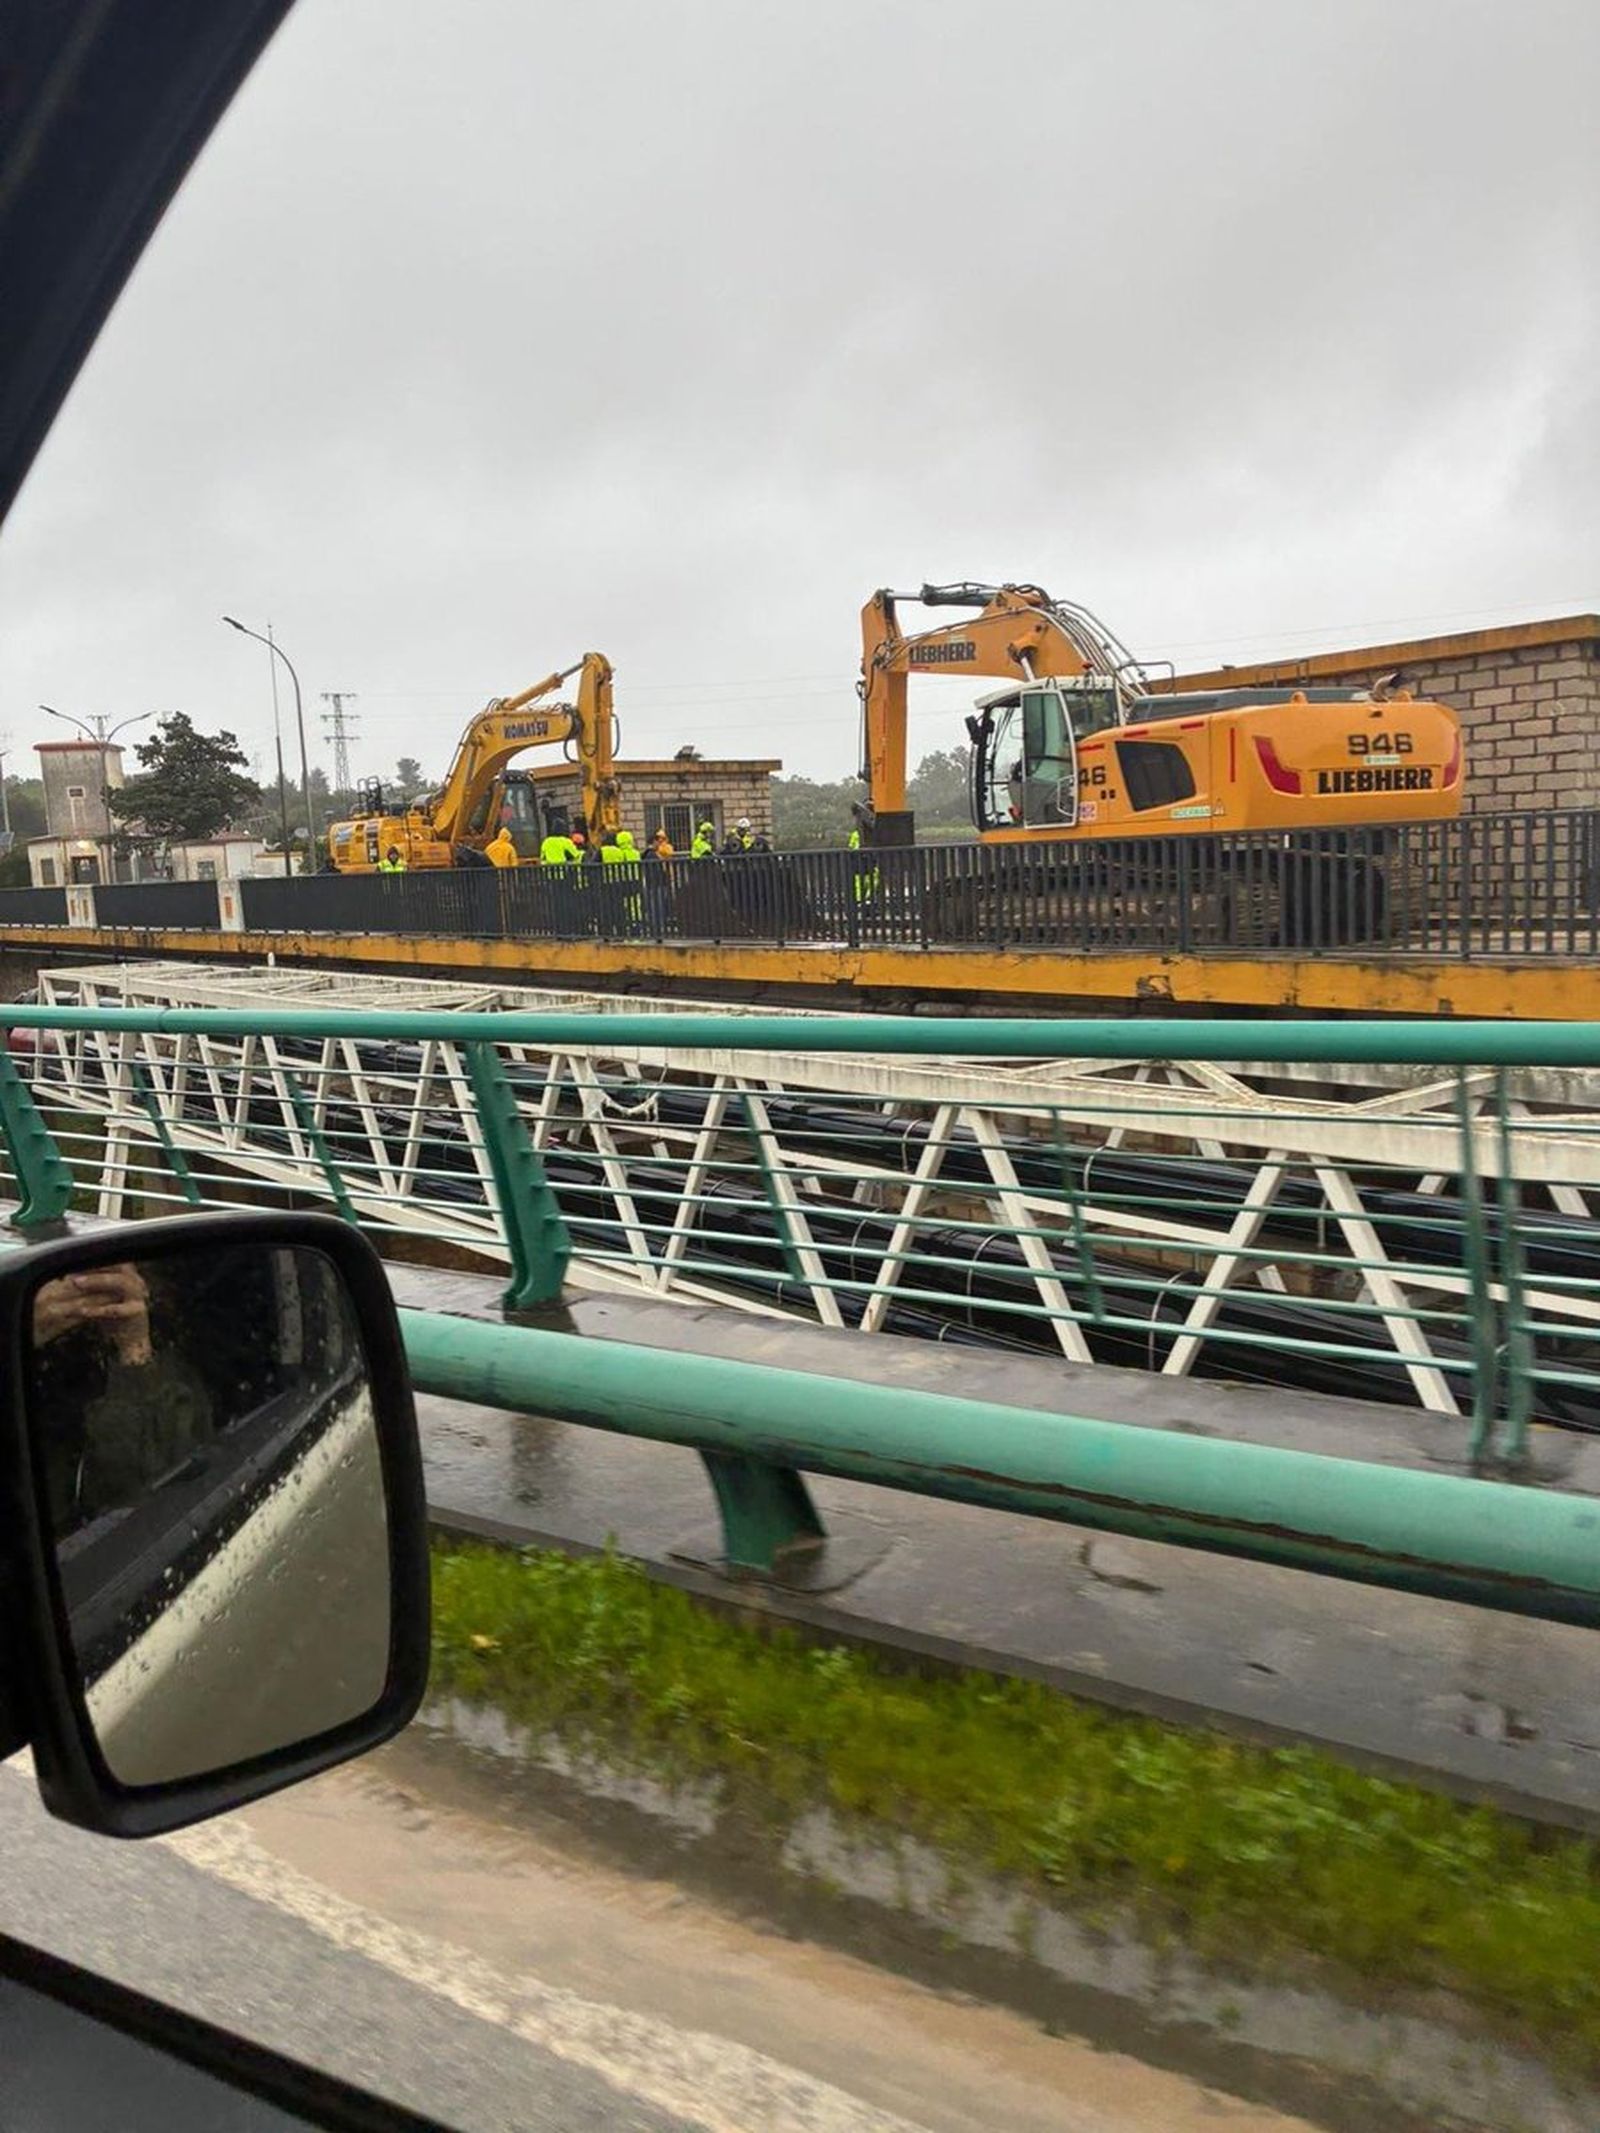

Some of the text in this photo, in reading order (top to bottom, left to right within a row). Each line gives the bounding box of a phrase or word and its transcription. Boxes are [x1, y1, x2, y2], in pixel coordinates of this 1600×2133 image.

[909, 641, 976, 663] LIEBHERR
[504, 720, 548, 739] KOMATSU
[1348, 733, 1412, 754] 946
[1077, 766, 1107, 786] 46
[1318, 768, 1432, 794] LIEBHERR
